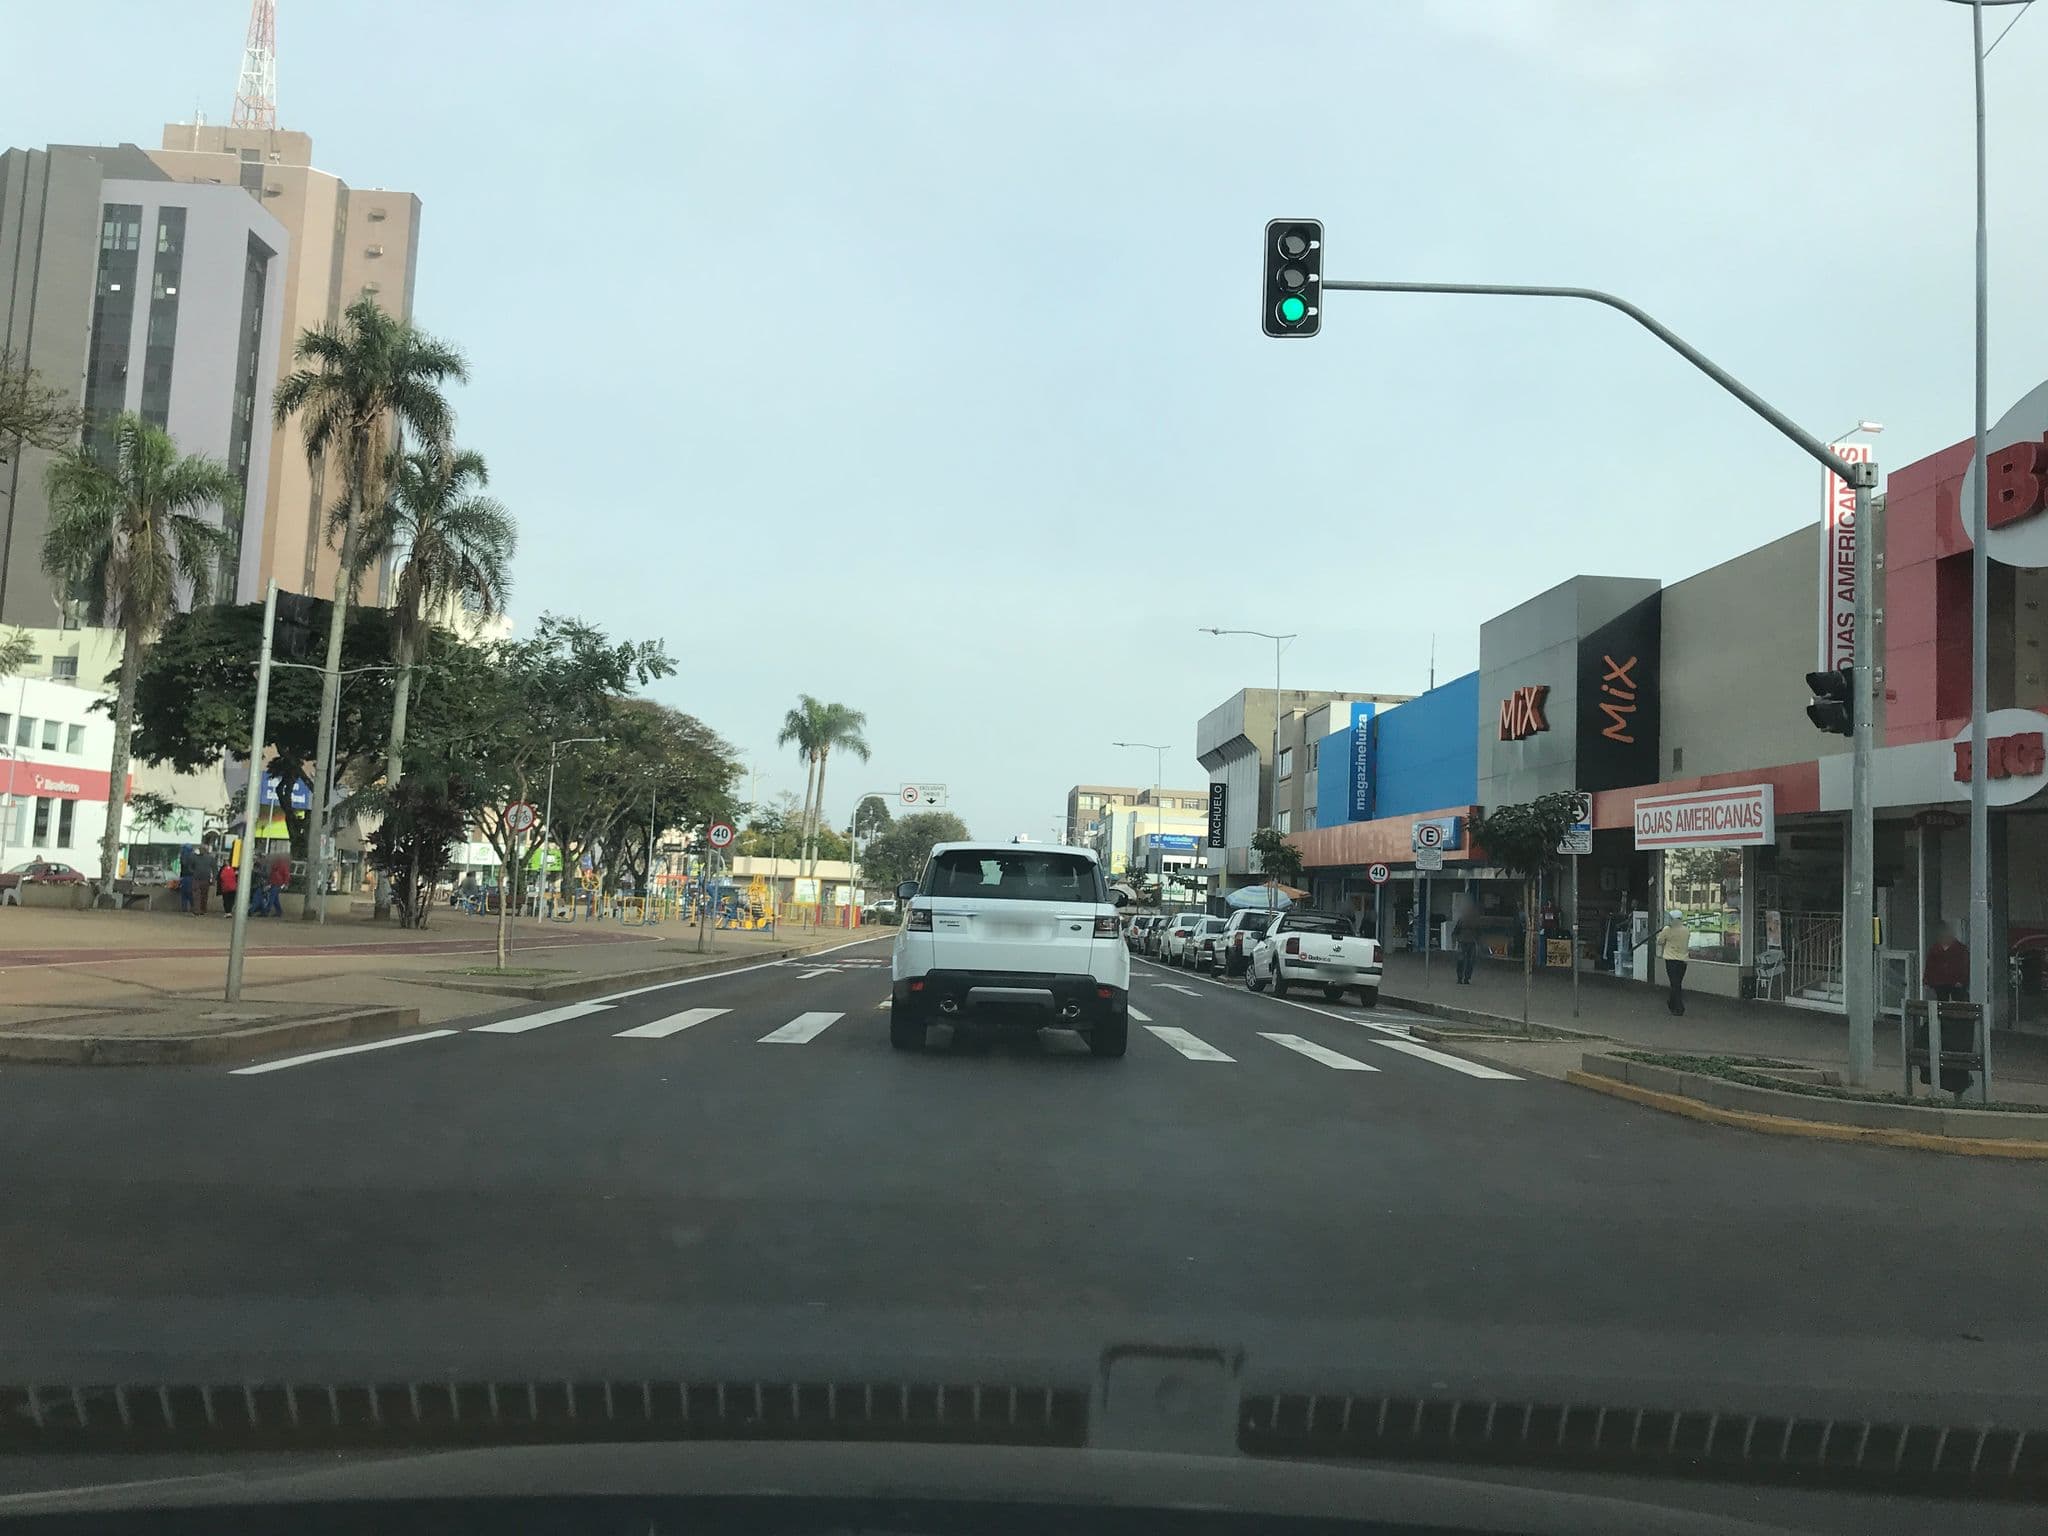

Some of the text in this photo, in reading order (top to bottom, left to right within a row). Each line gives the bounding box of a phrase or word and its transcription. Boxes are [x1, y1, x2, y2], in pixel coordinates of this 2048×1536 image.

[1355, 713, 1369, 811] magazineluiza
[1212, 785, 1222, 846] RIACHUELO
[1636, 801, 1763, 835] LOJAS AMERICANAS
[713, 828, 729, 839] 40
[1426, 830, 1434, 843] E
[1371, 866, 1386, 877] 40
